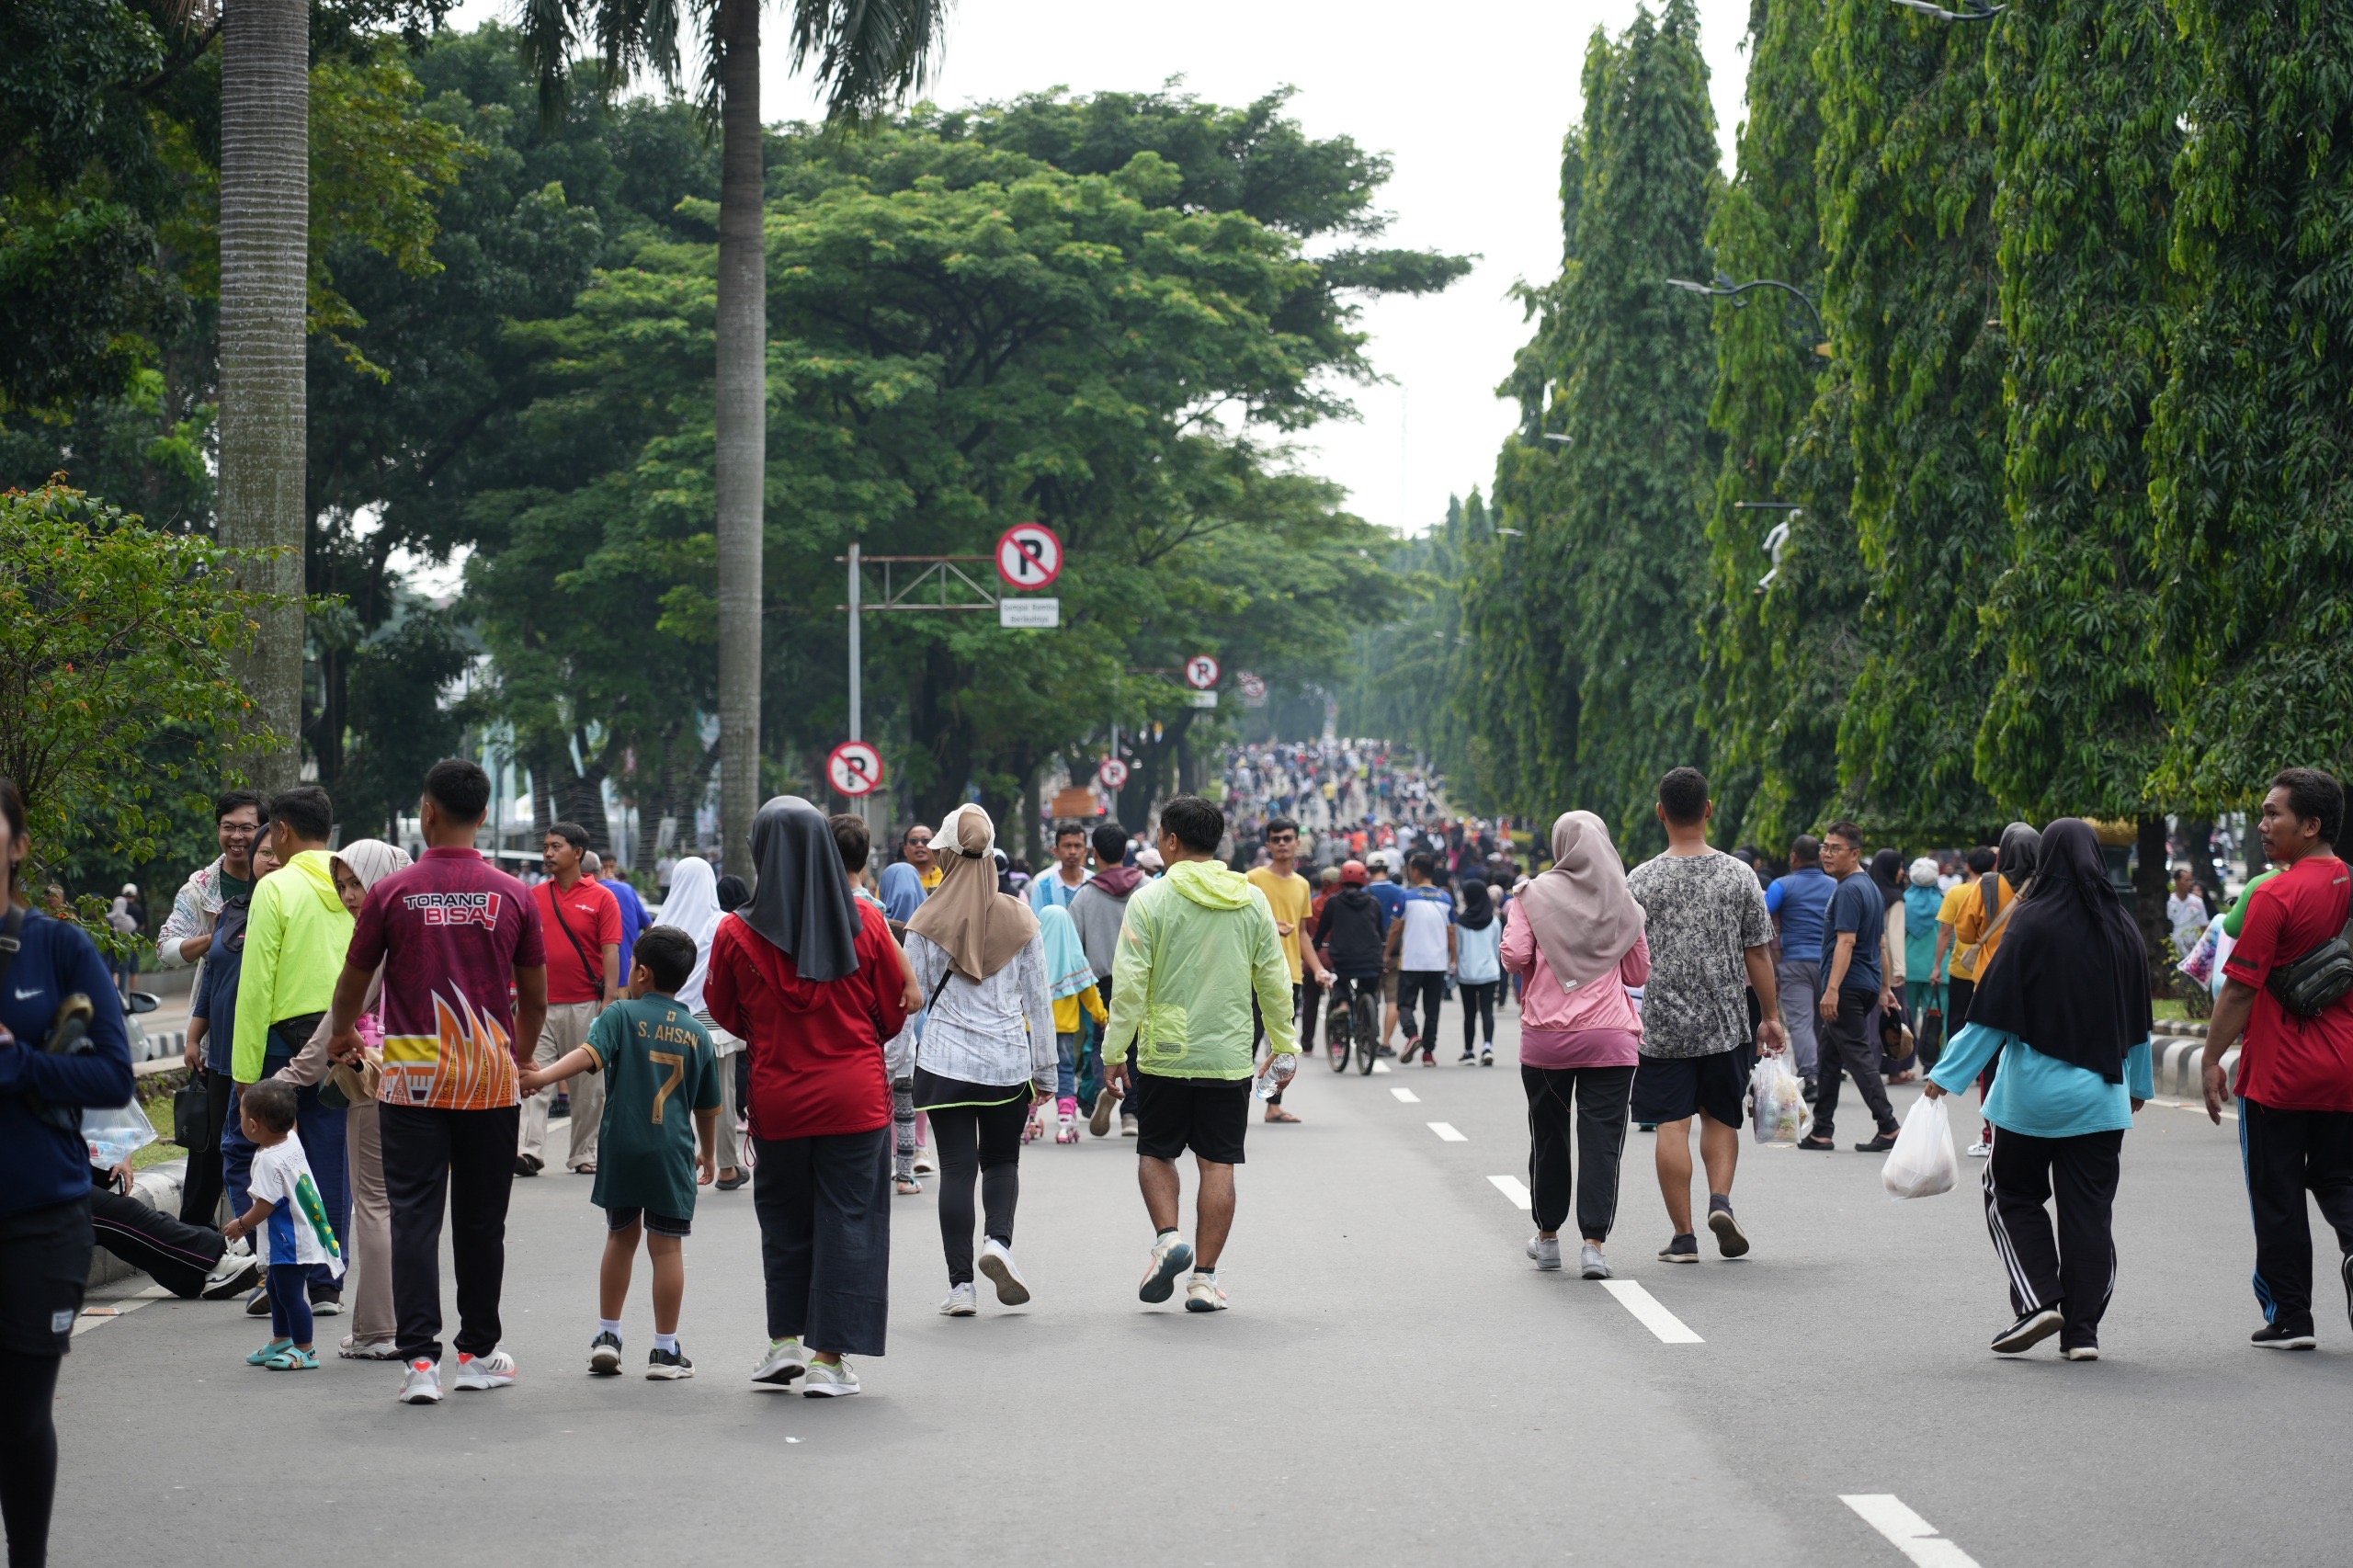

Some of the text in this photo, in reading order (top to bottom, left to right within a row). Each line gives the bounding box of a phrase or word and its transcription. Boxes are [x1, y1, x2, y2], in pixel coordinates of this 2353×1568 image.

[404, 893, 488, 910] TORANG
[638, 1020, 700, 1050] S. AHSAN
[649, 1050, 684, 1125] 7
